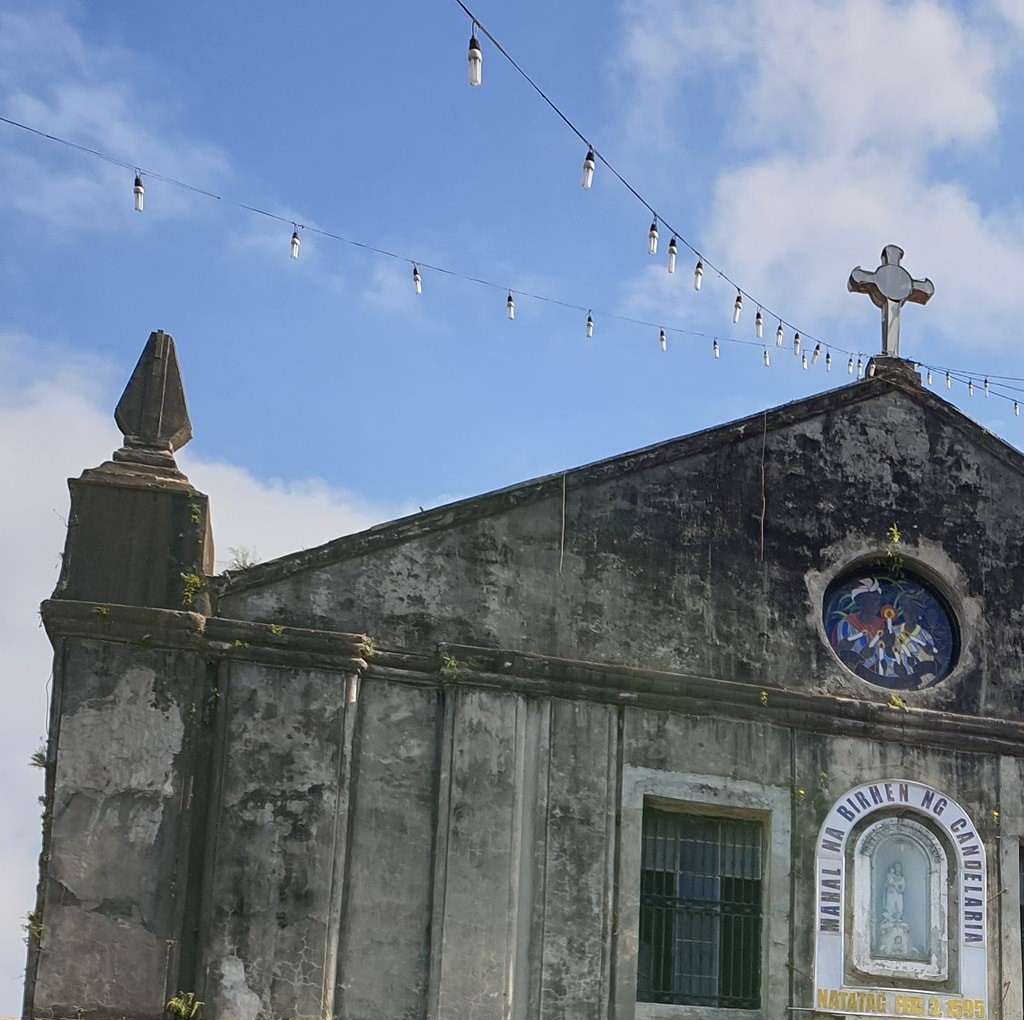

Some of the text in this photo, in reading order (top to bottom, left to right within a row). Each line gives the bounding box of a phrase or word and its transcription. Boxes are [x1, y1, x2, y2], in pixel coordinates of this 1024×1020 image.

[837, 784, 909, 823] BIRHEN
[921, 790, 948, 817] NG
[821, 827, 845, 853] NA
[949, 818, 984, 944] CANDELARIA
[820, 868, 841, 932] MAHAL
[946, 998, 985, 1018] 1595
